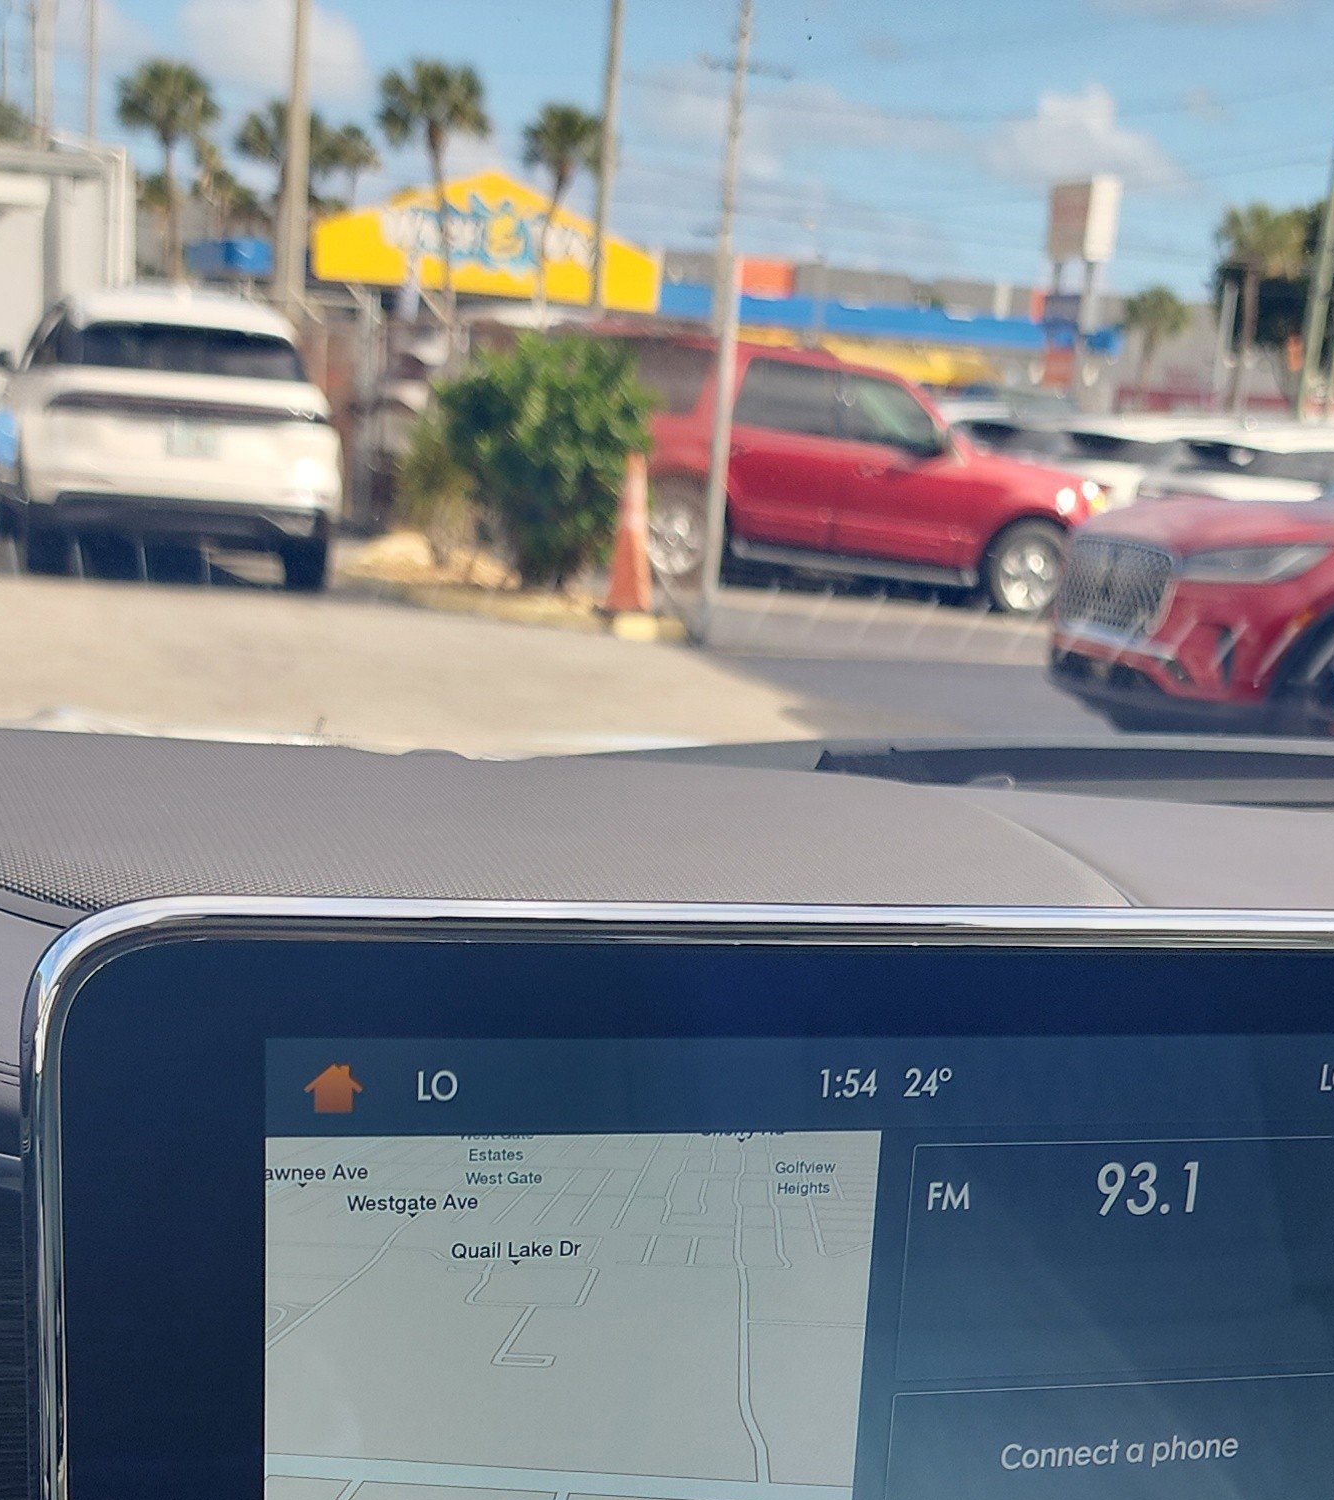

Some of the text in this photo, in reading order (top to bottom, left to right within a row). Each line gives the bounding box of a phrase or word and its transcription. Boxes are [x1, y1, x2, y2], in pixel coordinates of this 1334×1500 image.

[416, 1069, 459, 1102] LO
[819, 1068, 879, 1099] 1:54
[902, 1067, 953, 1098] 24°
[468, 1149, 524, 1163] Estates
[332, 1165, 369, 1180] Ave
[774, 1160, 836, 1175] Golfview
[465, 1171, 543, 1185] West Gate
[777, 1181, 830, 1197] Heights
[926, 1182, 971, 1212] FM
[1095, 1160, 1201, 1217] 93.1
[347, 1194, 479, 1214] Westgate Ave
[451, 1240, 582, 1260] Quail Lake Dr
[1000, 1434, 1240, 1471] Connect a phone
